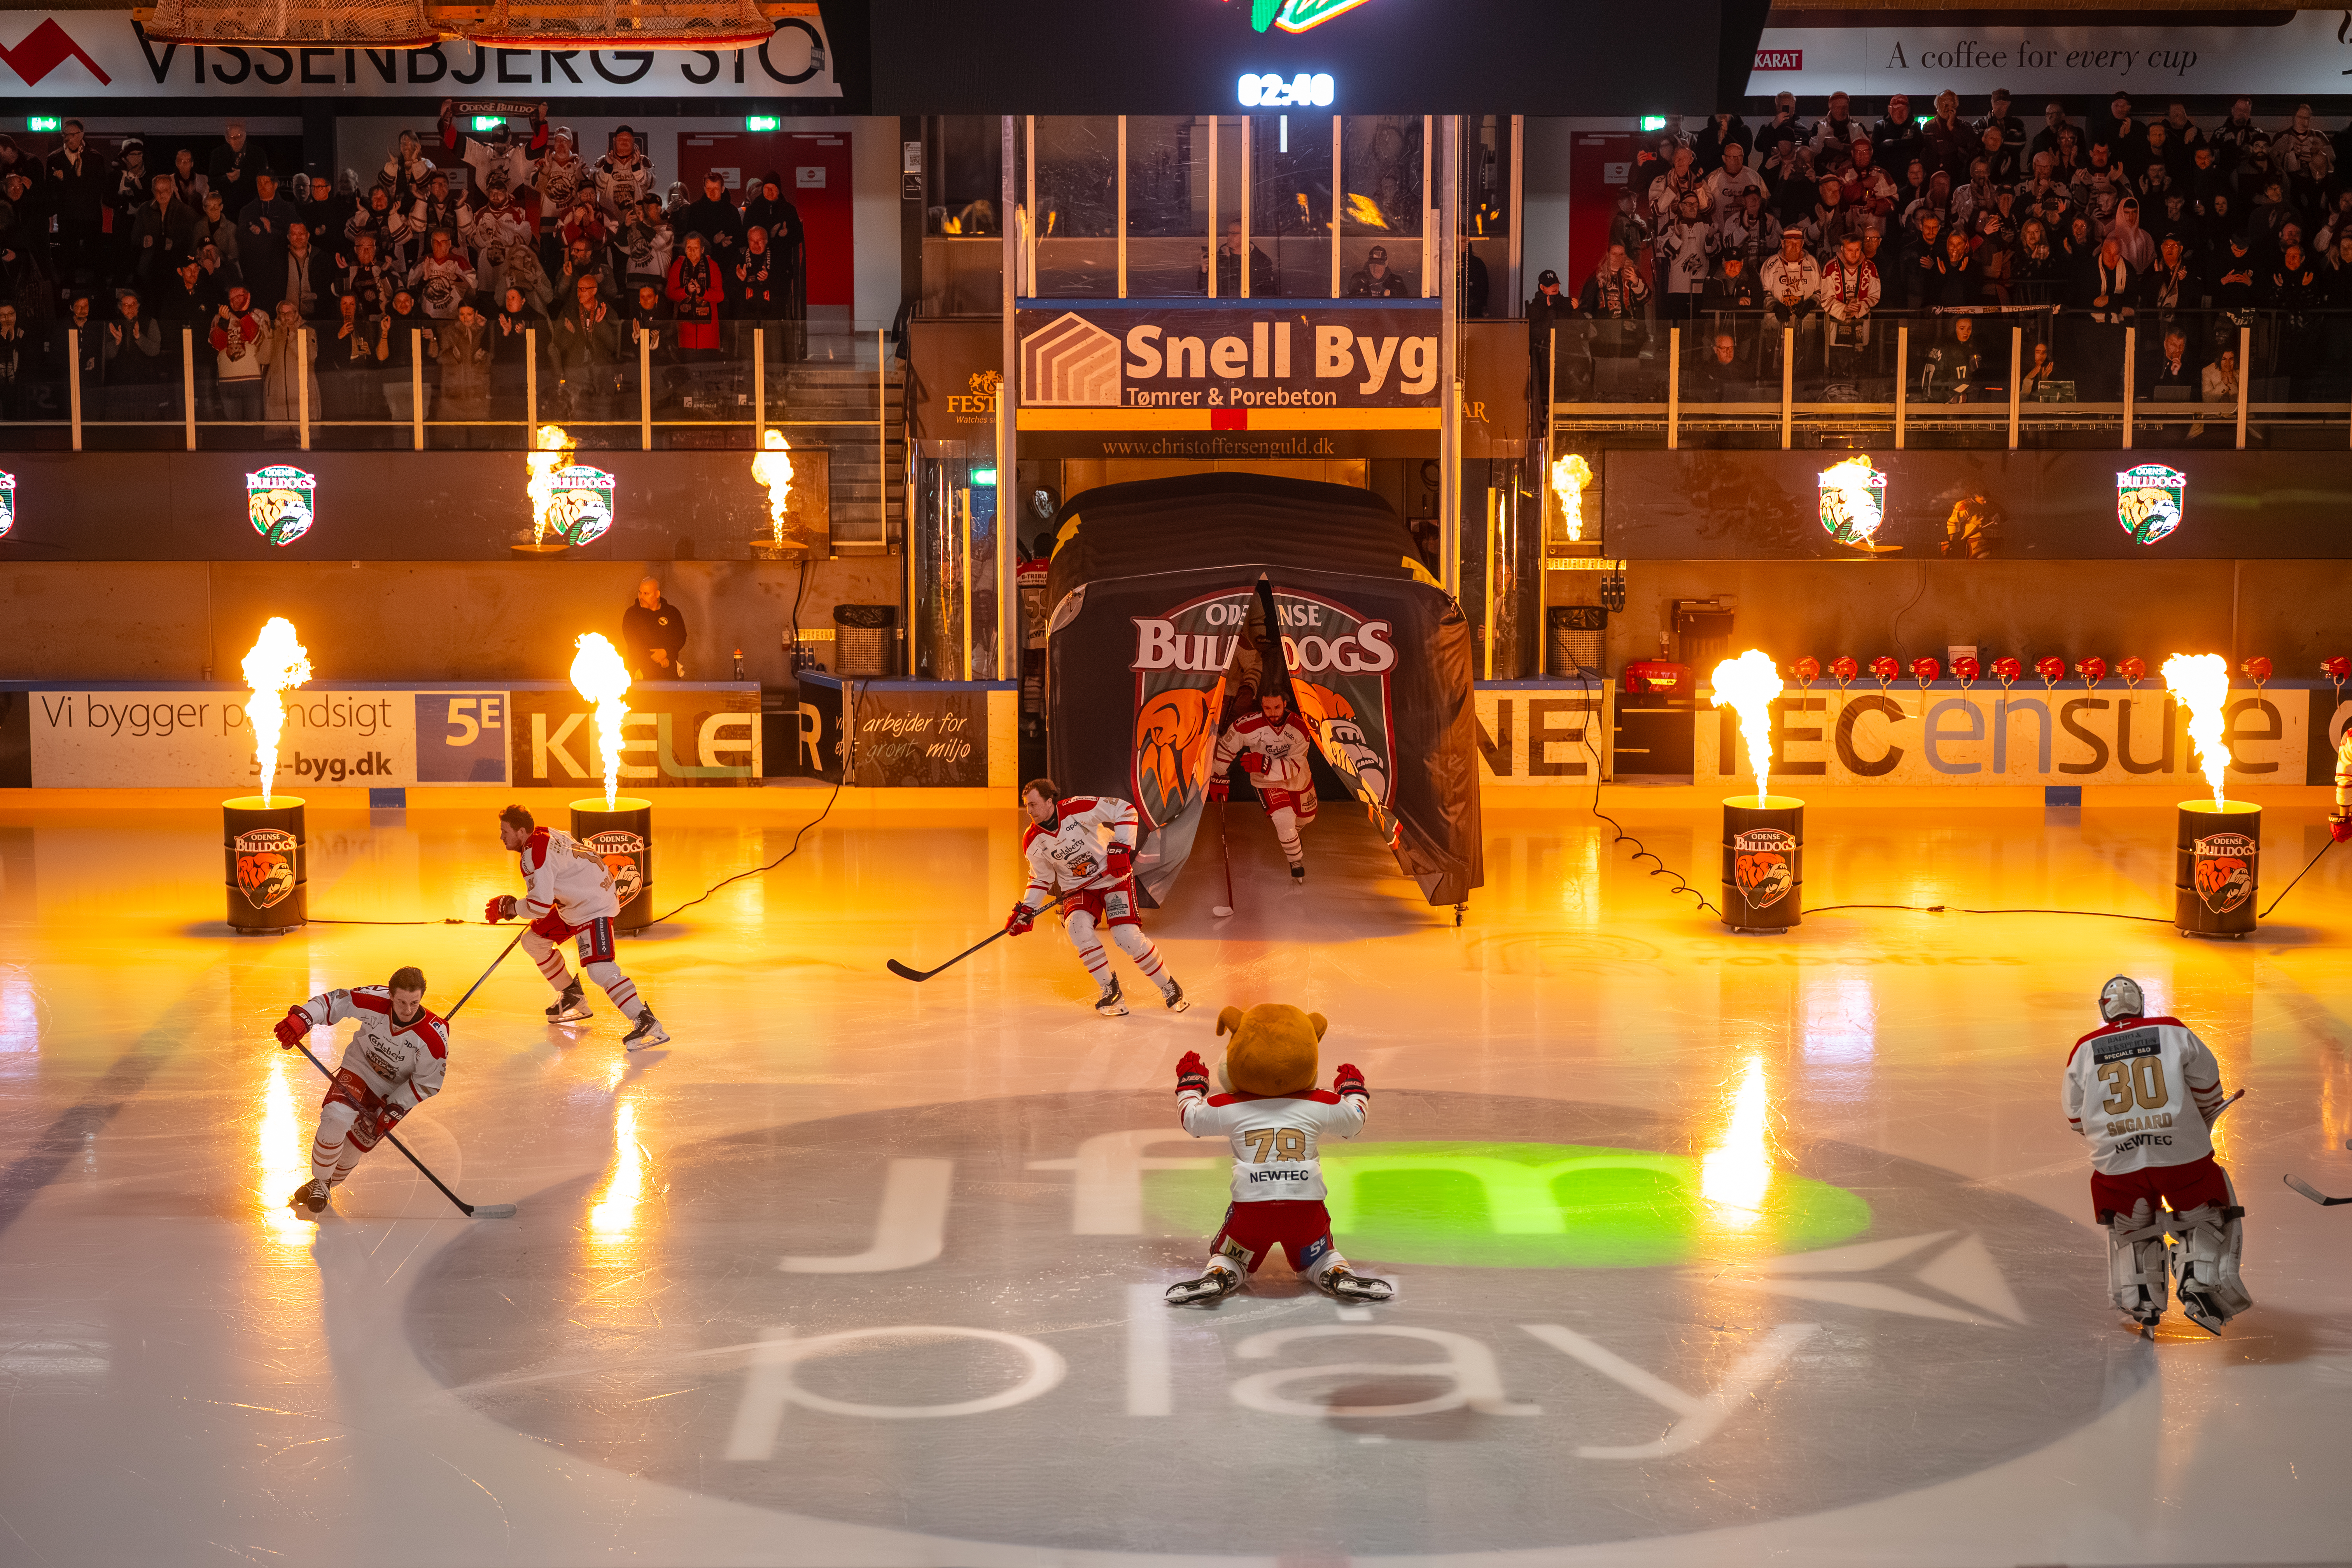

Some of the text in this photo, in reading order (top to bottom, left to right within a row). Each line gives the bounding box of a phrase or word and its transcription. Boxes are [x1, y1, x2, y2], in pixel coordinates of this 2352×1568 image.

[1754, 53, 1799, 68] KARAT
[1886, 40, 2198, 76] A coffee for every cup
[1125, 322, 1438, 395] Snell Byg
[1956, 366, 1966, 379] 17
[947, 395, 996, 413] FEST
[1126, 387, 1337, 406] Tømrer & Porebeton
[956, 415, 988, 424] Watches
[1102, 437, 1334, 458] www.christoffersenguld.dk
[245, 473, 316, 489] BULLDOGS
[2116, 472, 2186, 488] BULLDOGS
[1206, 603, 1321, 627] ODENSE
[1132, 619, 1396, 672] BULLDOGS
[42, 695, 74, 728] Vi
[88, 694, 209, 736] bygger
[286, 695, 392, 736] ndsigt
[446, 698, 501, 747] 5E
[863, 712, 968, 737] arbejder for
[865, 738, 971, 763] grønt miljø
[1066, 821, 1079, 832] apol
[235, 835, 298, 853] BULLDOGS
[251, 833, 281, 842] ODENSE
[583, 838, 644, 854] BULLDOGS
[1734, 835, 1795, 853] BULLDOGS
[1751, 832, 1781, 841] ODENSE
[2213, 836, 2243, 845] ODENSE
[1051, 838, 1085, 861] Carlsberg
[2195, 839, 2256, 856] BULLDOGS
[368, 1034, 405, 1063] Carlsberg
[2104, 1050, 2134, 1060] SPECIALE
[2097, 1055, 2169, 1115] 30
[2106, 1112, 2173, 1137] SØGAARD
[1244, 1128, 1306, 1164] 78
[2115, 1134, 2173, 1154] NEWTEC
[1250, 1170, 1309, 1183] NEWTEC
[724, 1283, 1821, 1461] play
